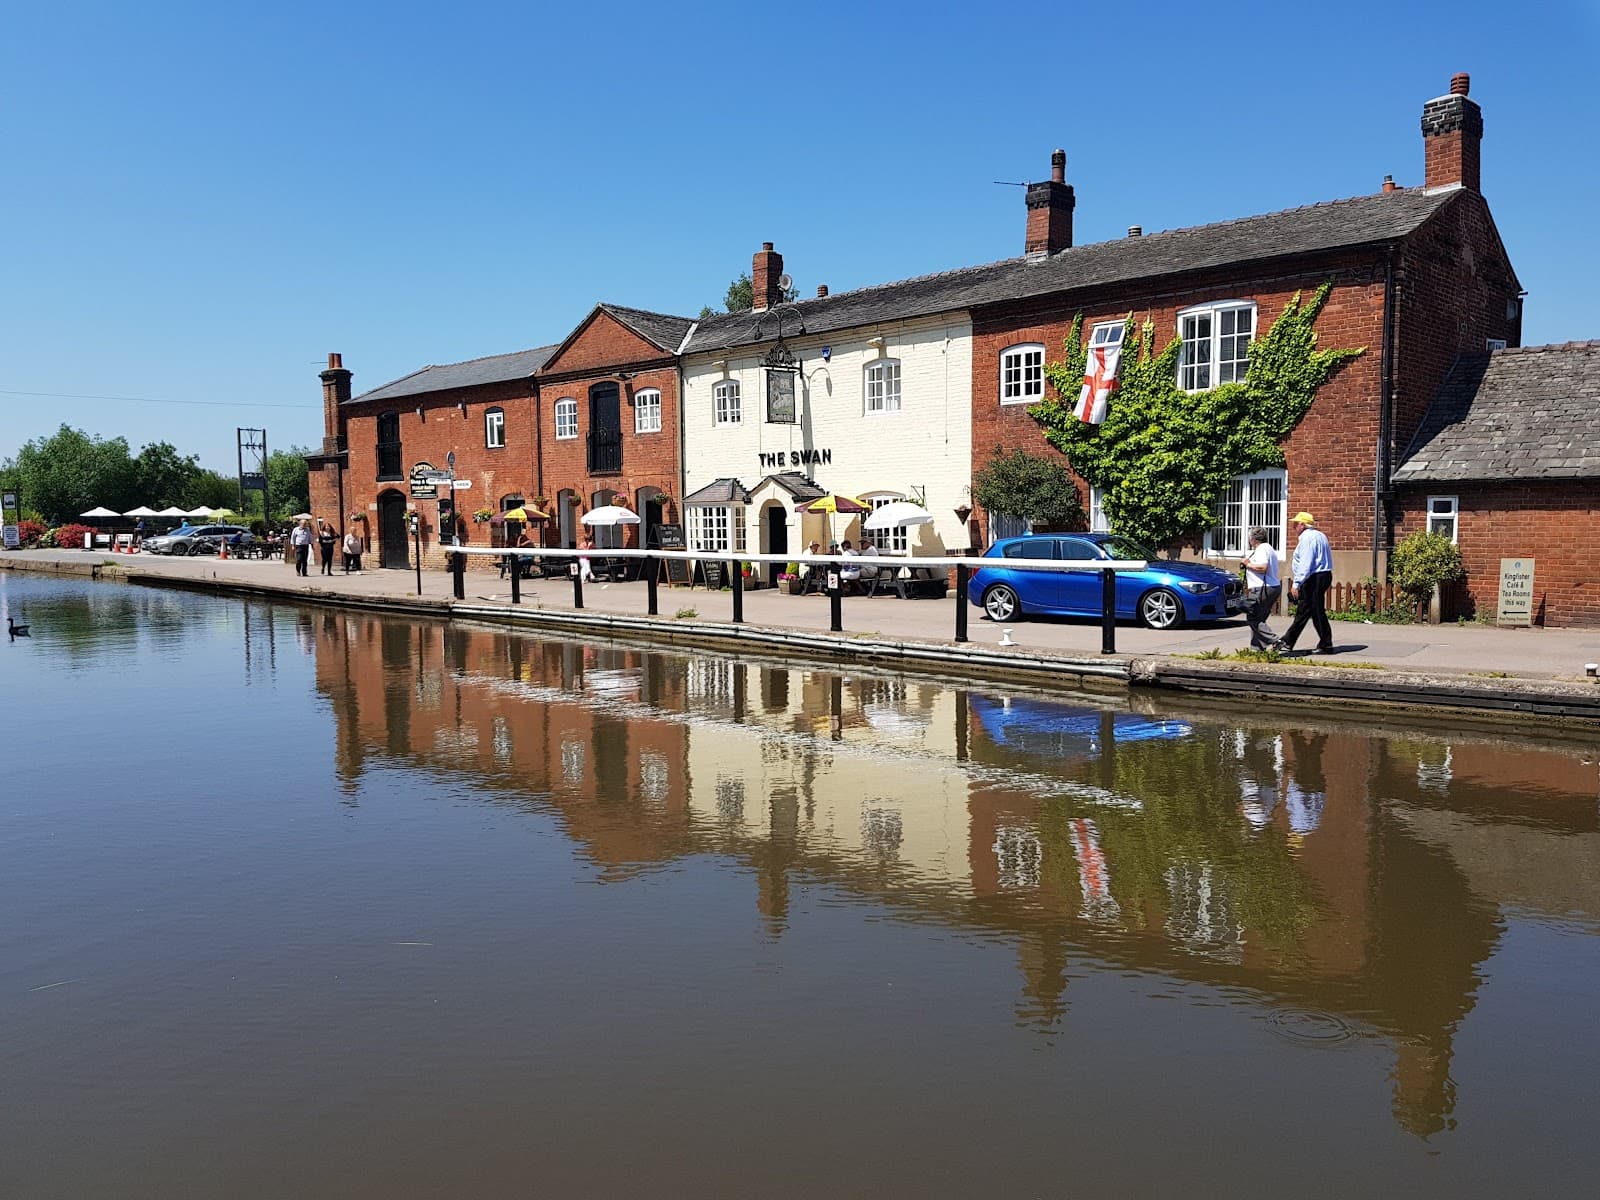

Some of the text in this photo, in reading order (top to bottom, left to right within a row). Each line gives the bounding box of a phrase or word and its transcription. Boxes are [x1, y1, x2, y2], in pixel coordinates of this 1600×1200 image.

[758, 449, 831, 467] THE SWAN
[1504, 573, 1530, 581] Kingfisher
[1506, 581, 1519, 589] Café
[1504, 598, 1514, 606] this
